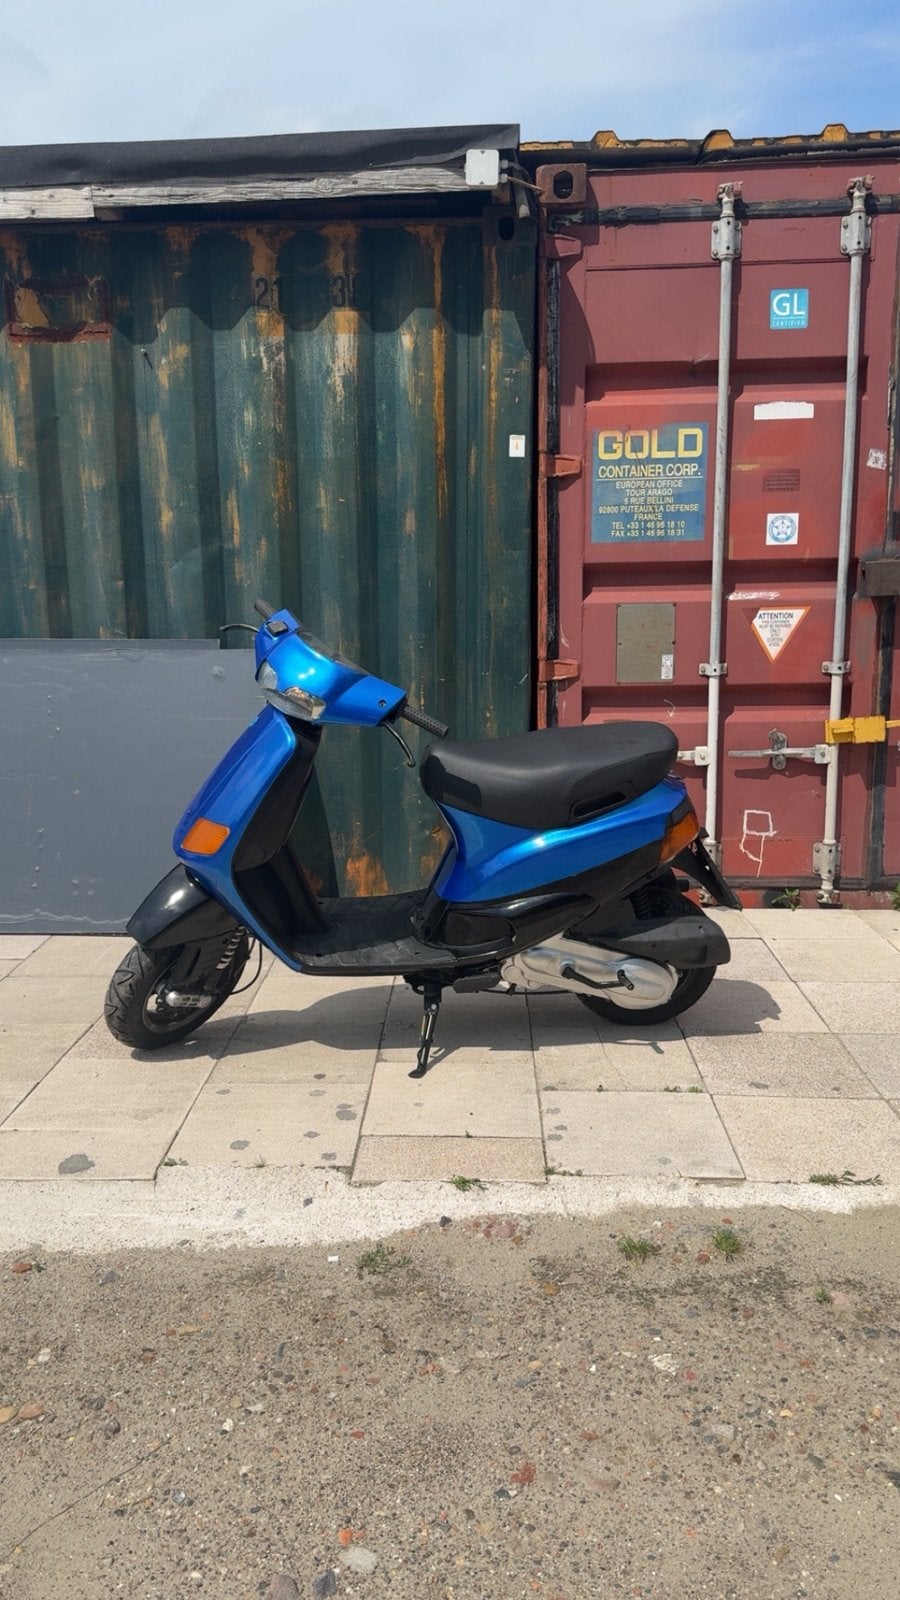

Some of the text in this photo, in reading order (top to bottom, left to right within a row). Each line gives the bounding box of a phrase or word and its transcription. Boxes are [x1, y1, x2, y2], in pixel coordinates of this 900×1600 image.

[773, 293, 806, 316] GL
[598, 428, 703, 460] GOLD
[598, 463, 701, 478] CONTAINER CORP.
[616, 480, 683, 489] EUROPEAN OFFICE
[625, 488, 673, 497] TOUR ARAGO
[630, 497, 645, 505] RUE
[646, 496, 674, 504] BELLINI
[598, 506, 619, 514] 92800
[666, 504, 699, 512] DEFENSE
[634, 513, 663, 521] FRANCE
[758, 612, 794, 620] ATTENTION
